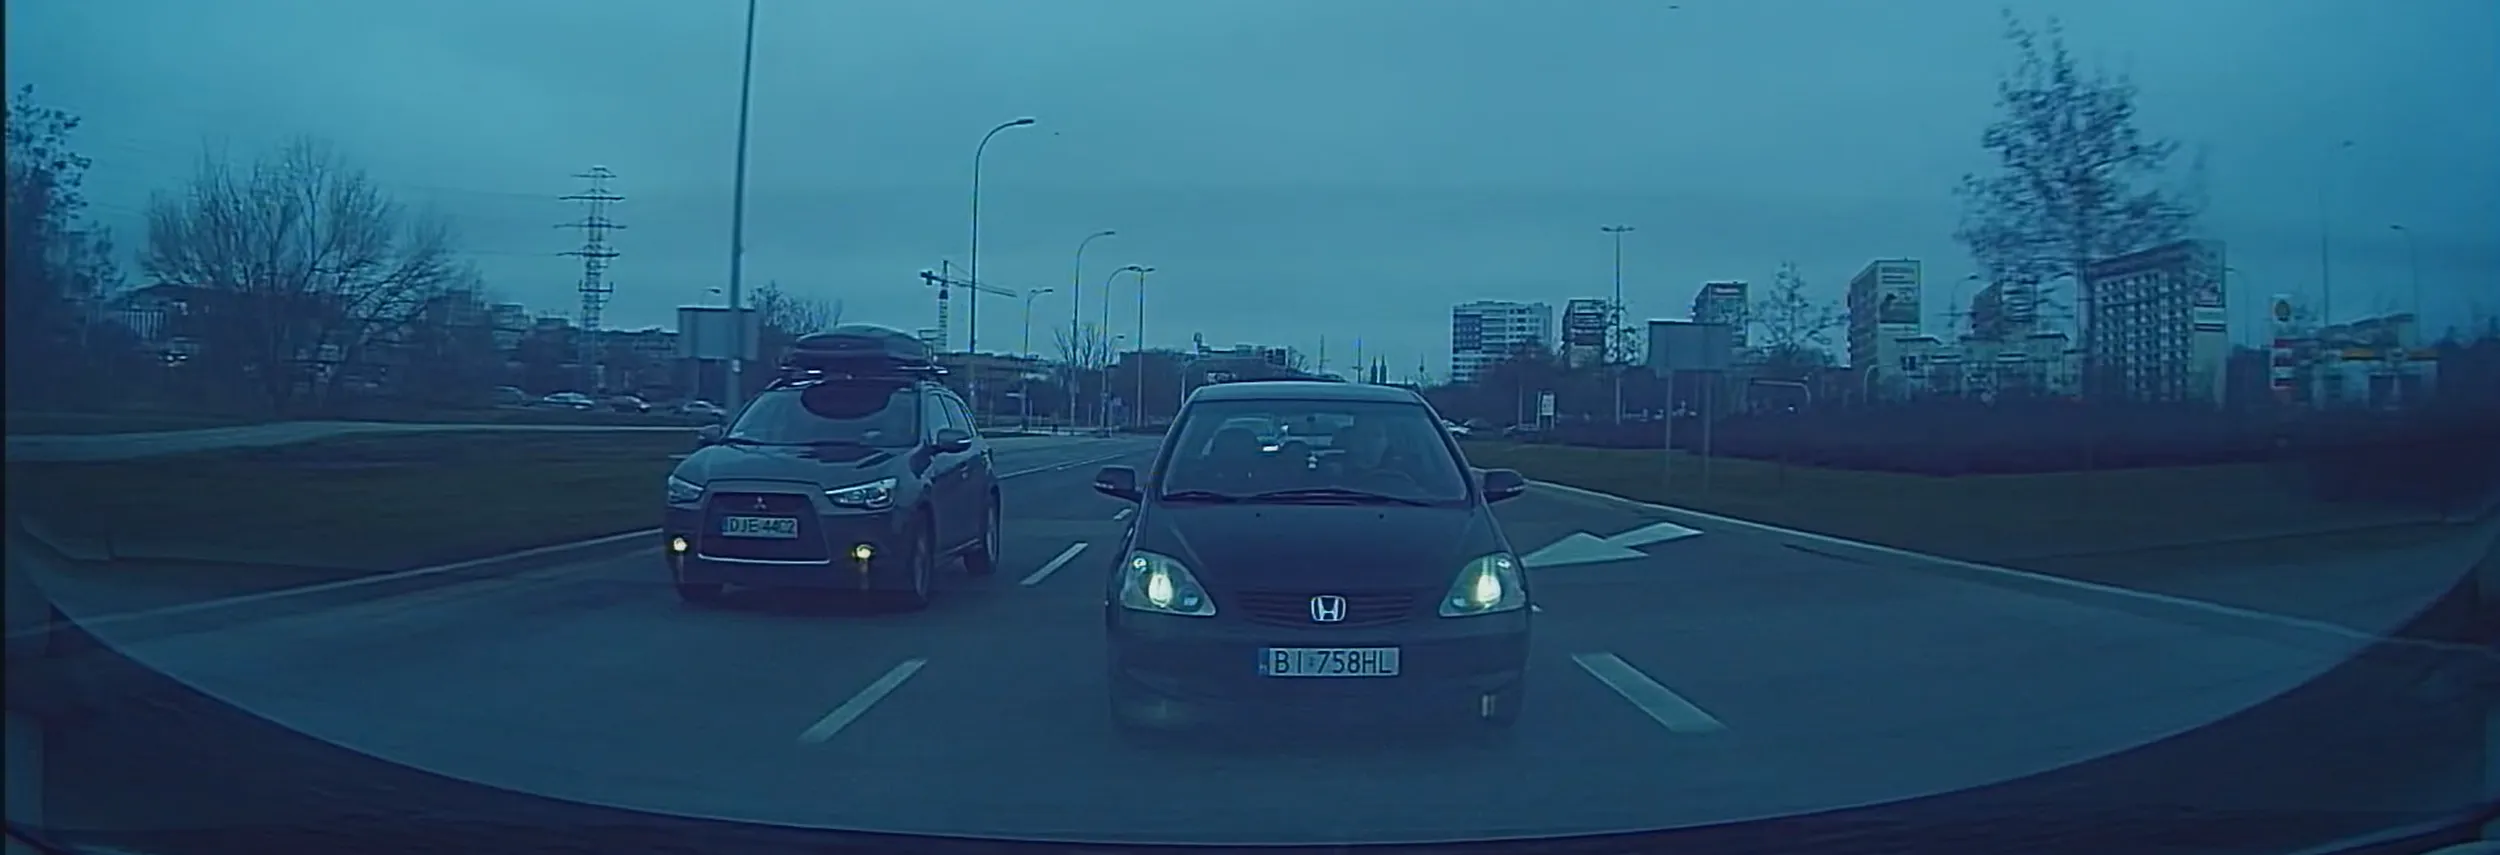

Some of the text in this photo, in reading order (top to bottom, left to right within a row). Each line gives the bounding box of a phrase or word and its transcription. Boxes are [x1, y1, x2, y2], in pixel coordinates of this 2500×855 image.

[730, 518, 758, 533] DJE
[1275, 650, 1392, 674] BI 758HL
